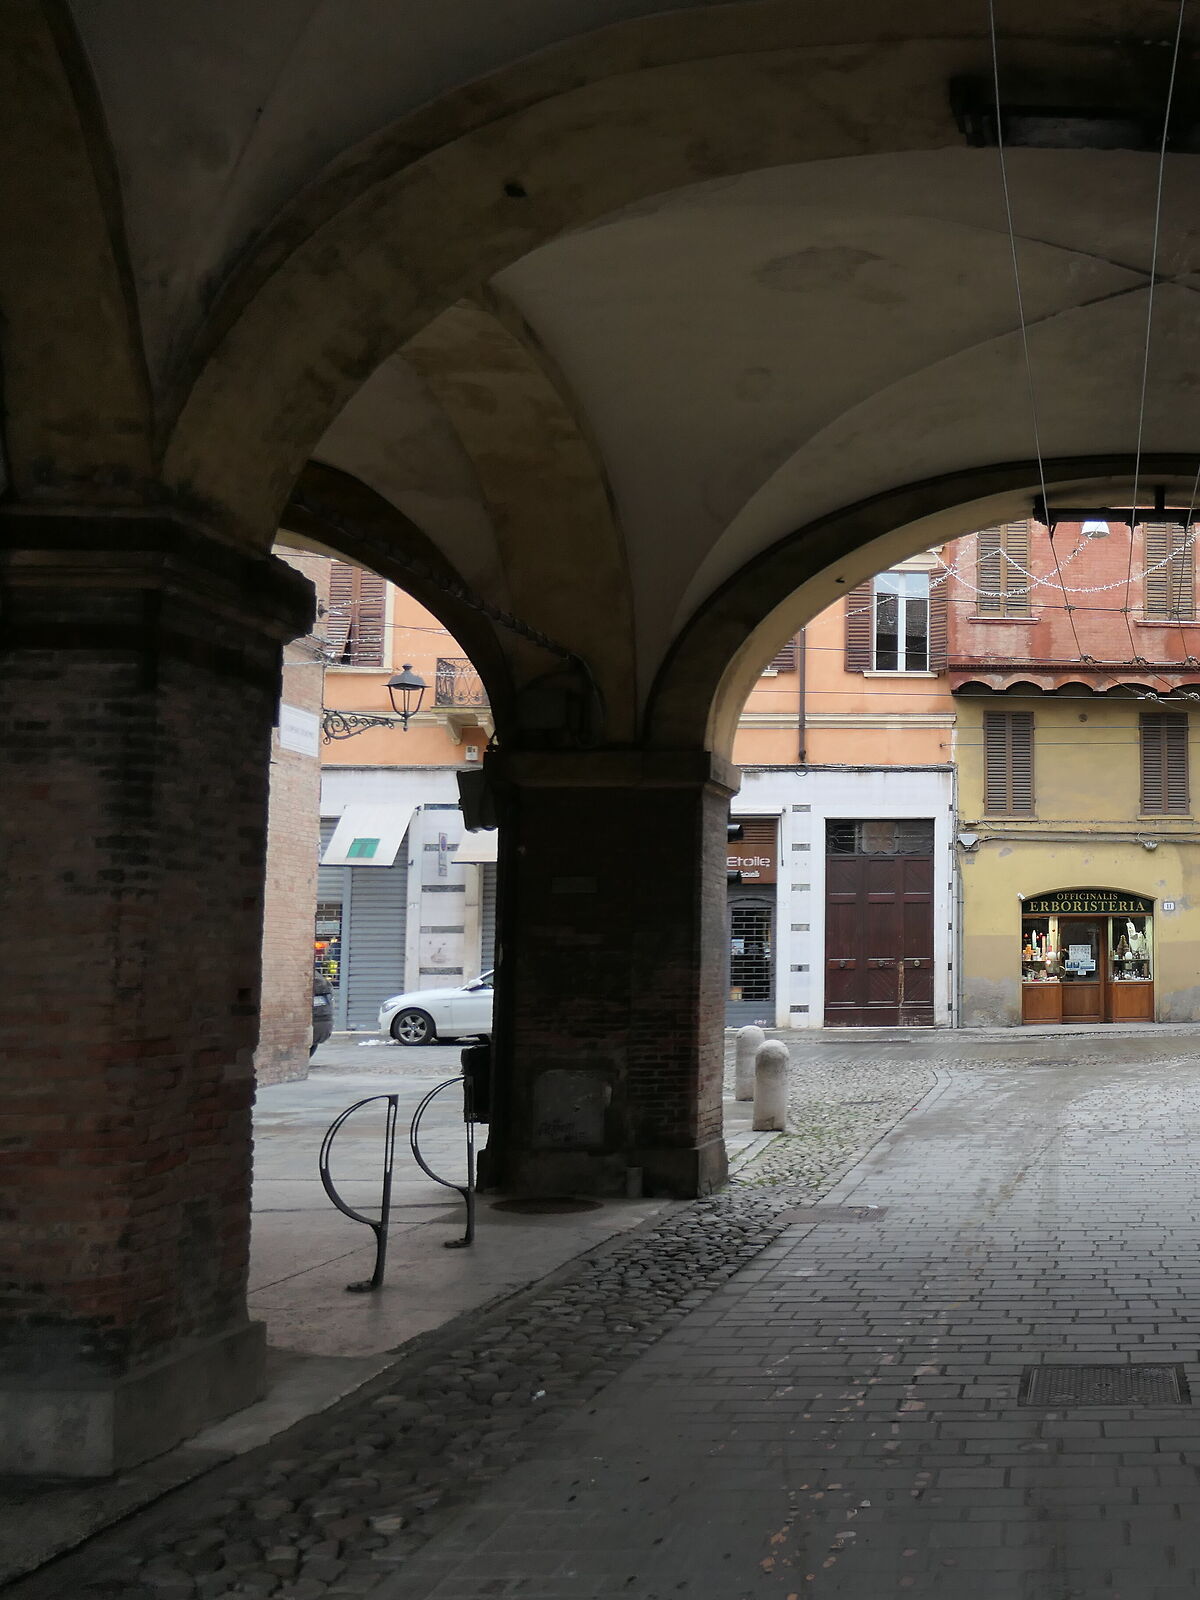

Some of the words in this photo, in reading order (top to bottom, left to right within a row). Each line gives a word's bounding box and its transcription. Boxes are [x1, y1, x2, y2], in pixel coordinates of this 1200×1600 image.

[726, 856, 771, 867] Etoile
[1056, 892, 1118, 901] OFFICINALIS
[1029, 901, 1146, 912] ERBORISTERIA
